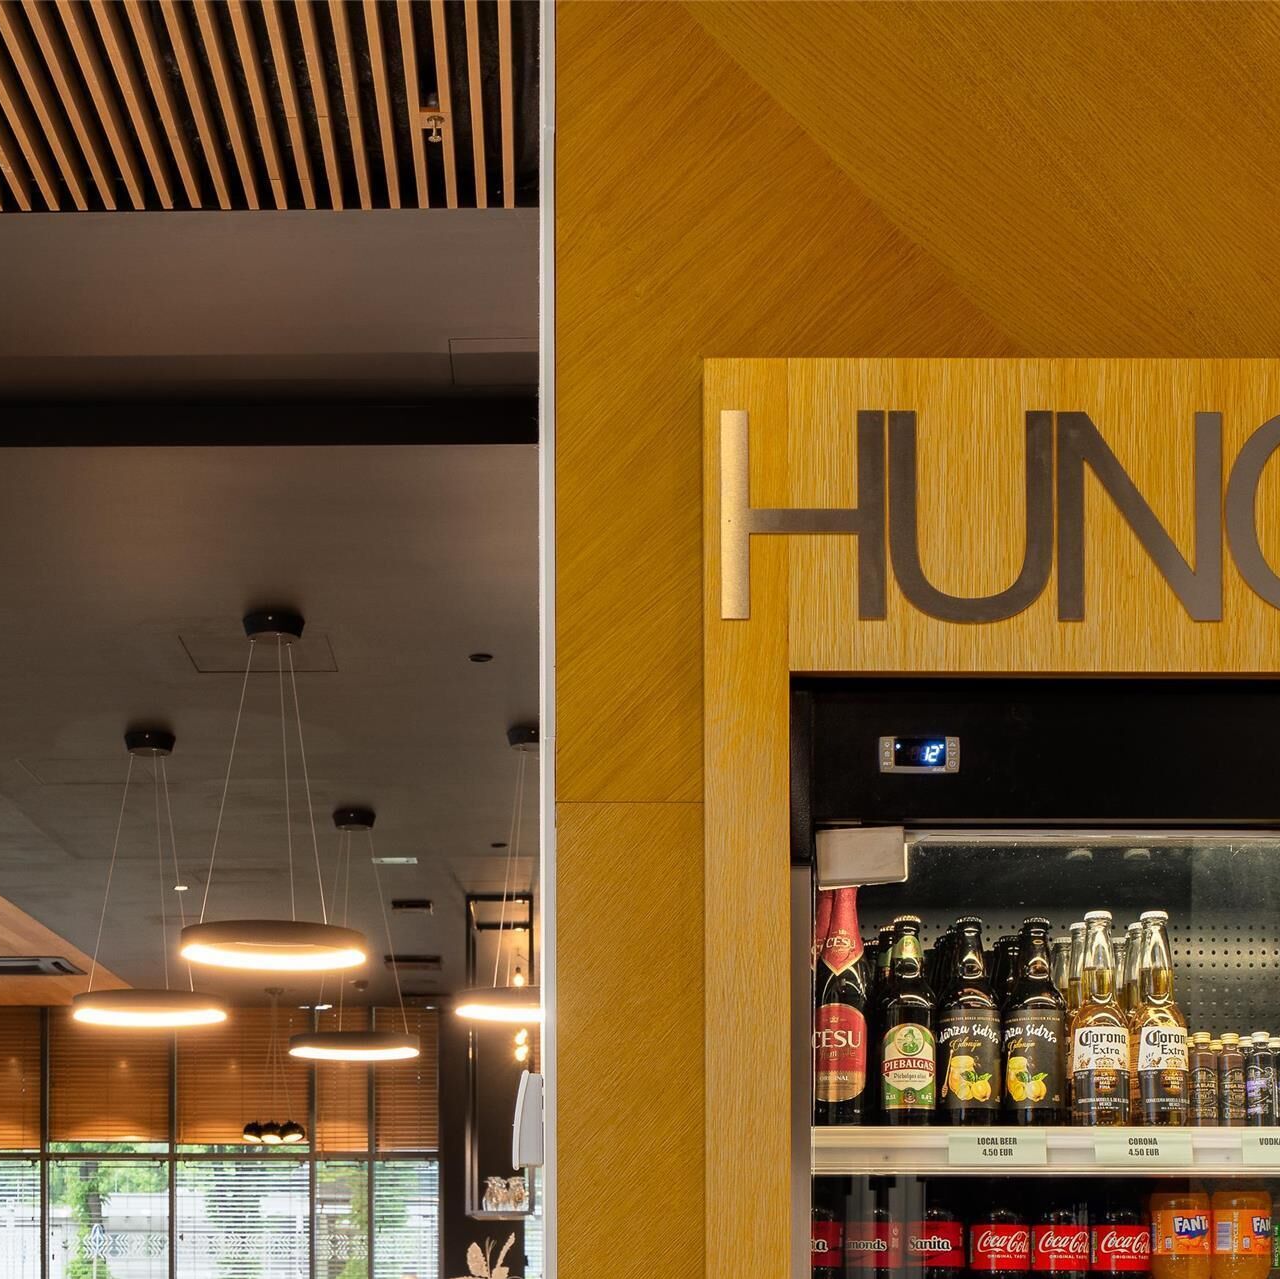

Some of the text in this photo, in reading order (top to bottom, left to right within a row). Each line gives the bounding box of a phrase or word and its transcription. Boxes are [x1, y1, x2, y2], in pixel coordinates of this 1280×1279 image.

[1080, 1030, 1126, 1047] Corona
[1146, 1030, 1187, 1047] Coron
[1092, 1045, 1120, 1055] Extra
[1161, 1045, 1185, 1056] Extra
[884, 1059, 934, 1072] PIEBALGAS
[977, 1137, 1018, 1145] LOCAL BEER
[1128, 1137, 1158, 1145] CORONA
[982, 1149, 1013, 1157] 4.50 EUR
[1128, 1149, 1160, 1157] 4.50 EUR
[1173, 1215, 1209, 1233] FANT
[847, 1239, 887, 1251] monds
[908, 1236, 951, 1252] Sanita
